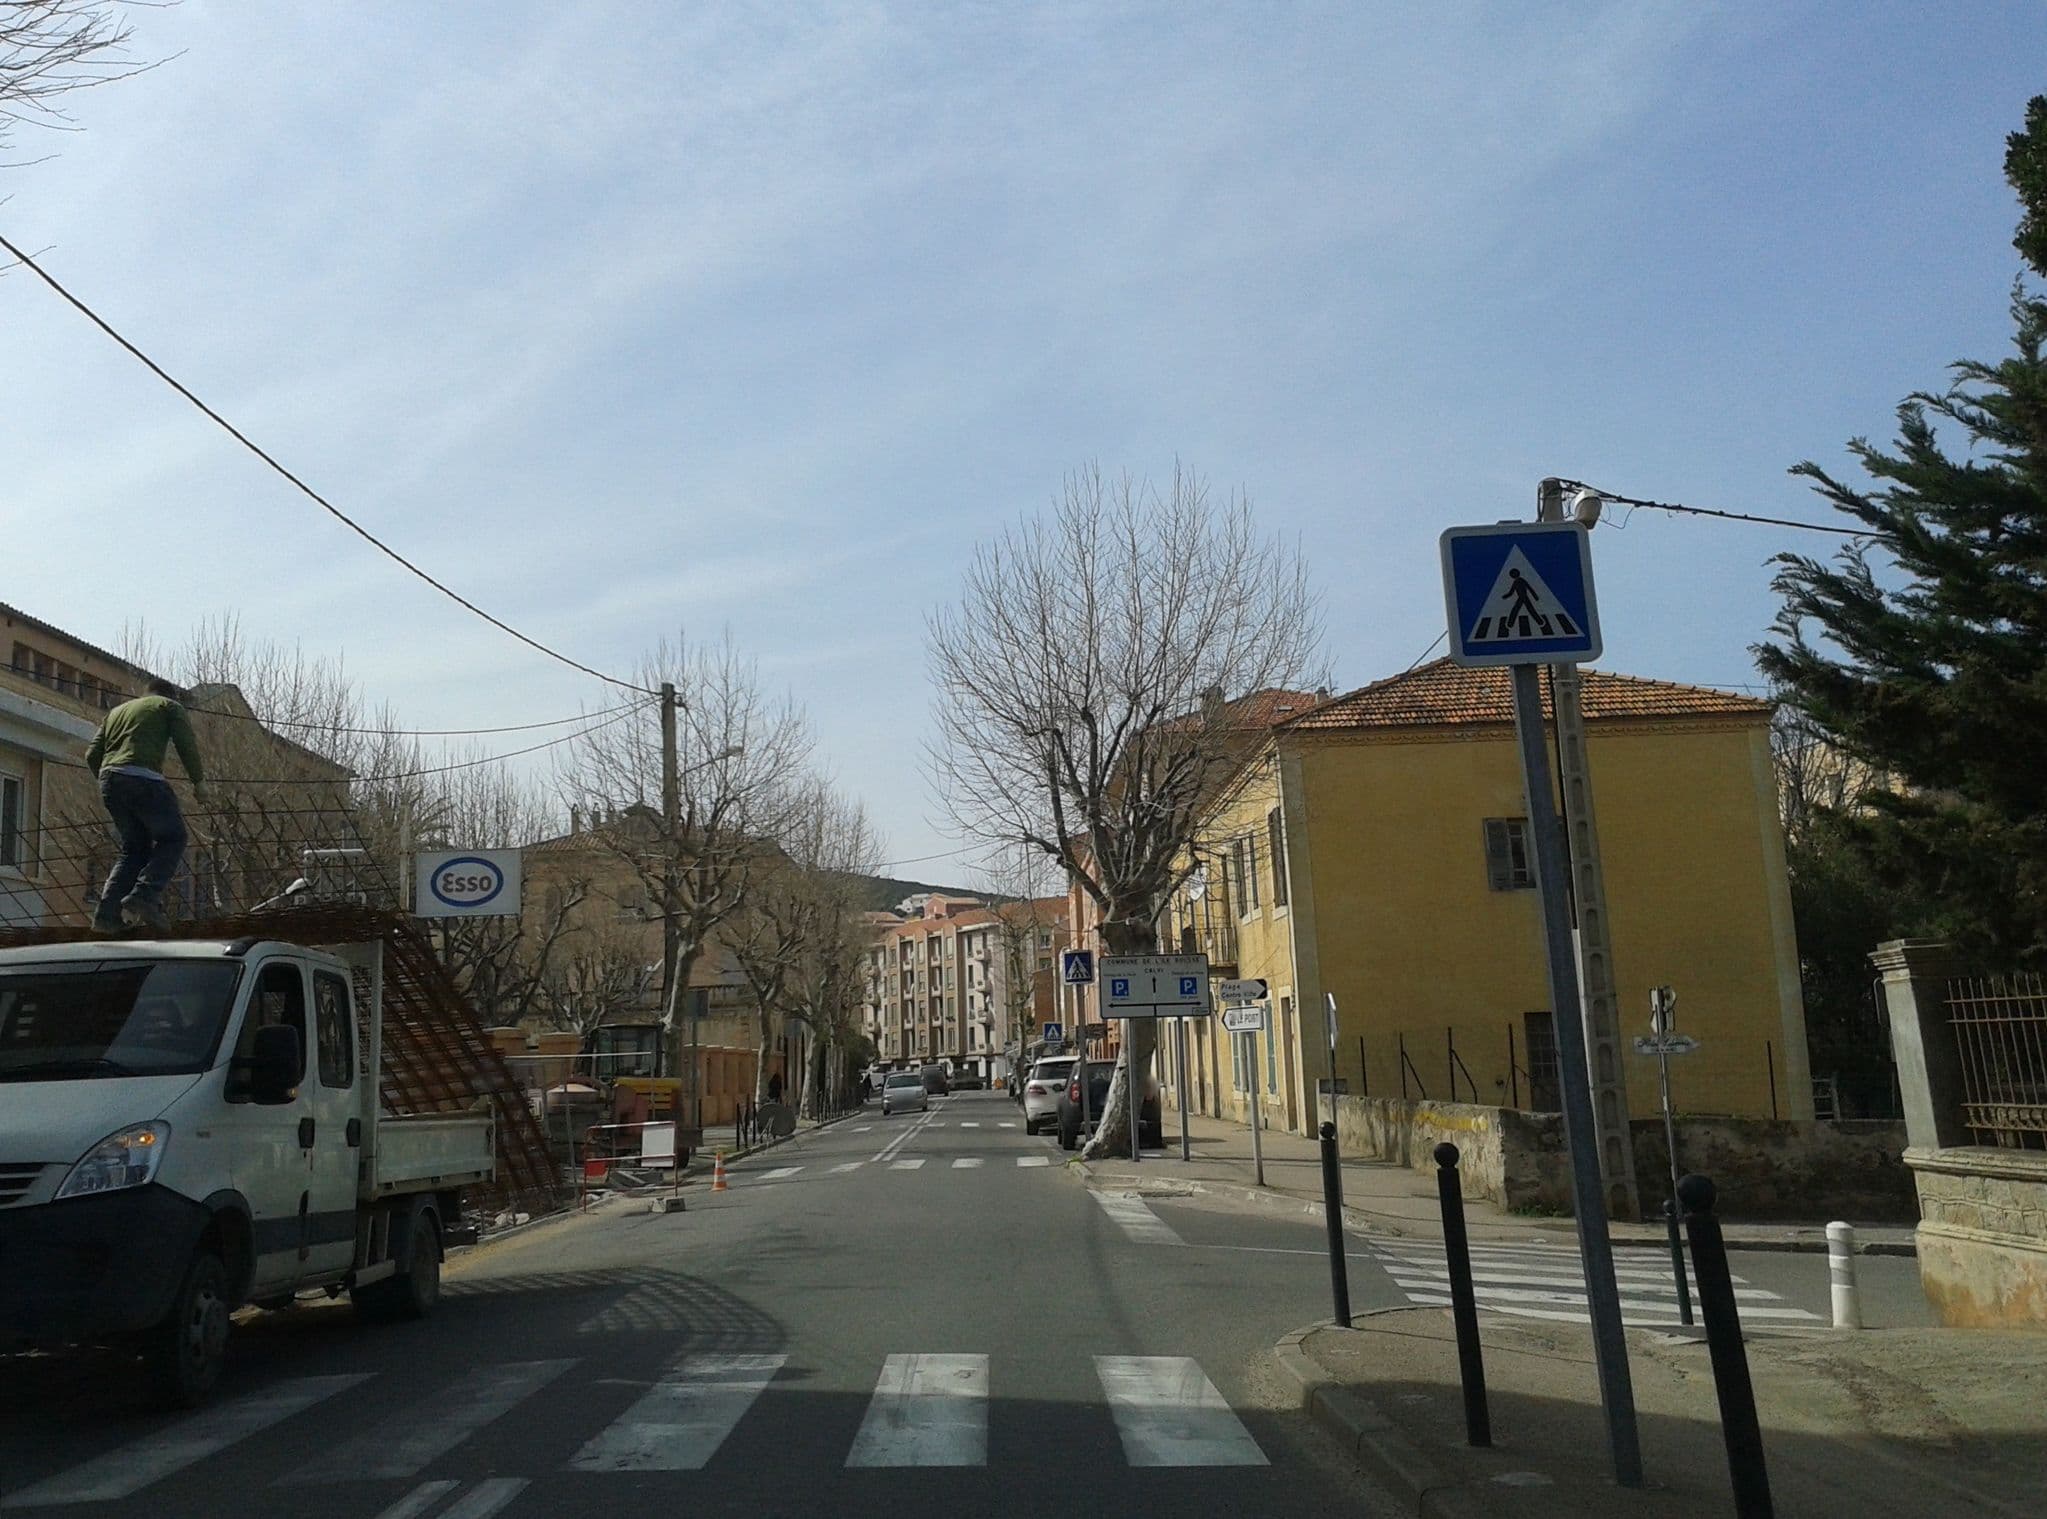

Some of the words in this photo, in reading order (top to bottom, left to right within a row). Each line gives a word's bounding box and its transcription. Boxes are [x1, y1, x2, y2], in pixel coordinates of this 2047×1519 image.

[1143, 967, 1165, 975] CALVI
[1115, 981, 1125, 994] P
[1184, 979, 1194, 992] P
